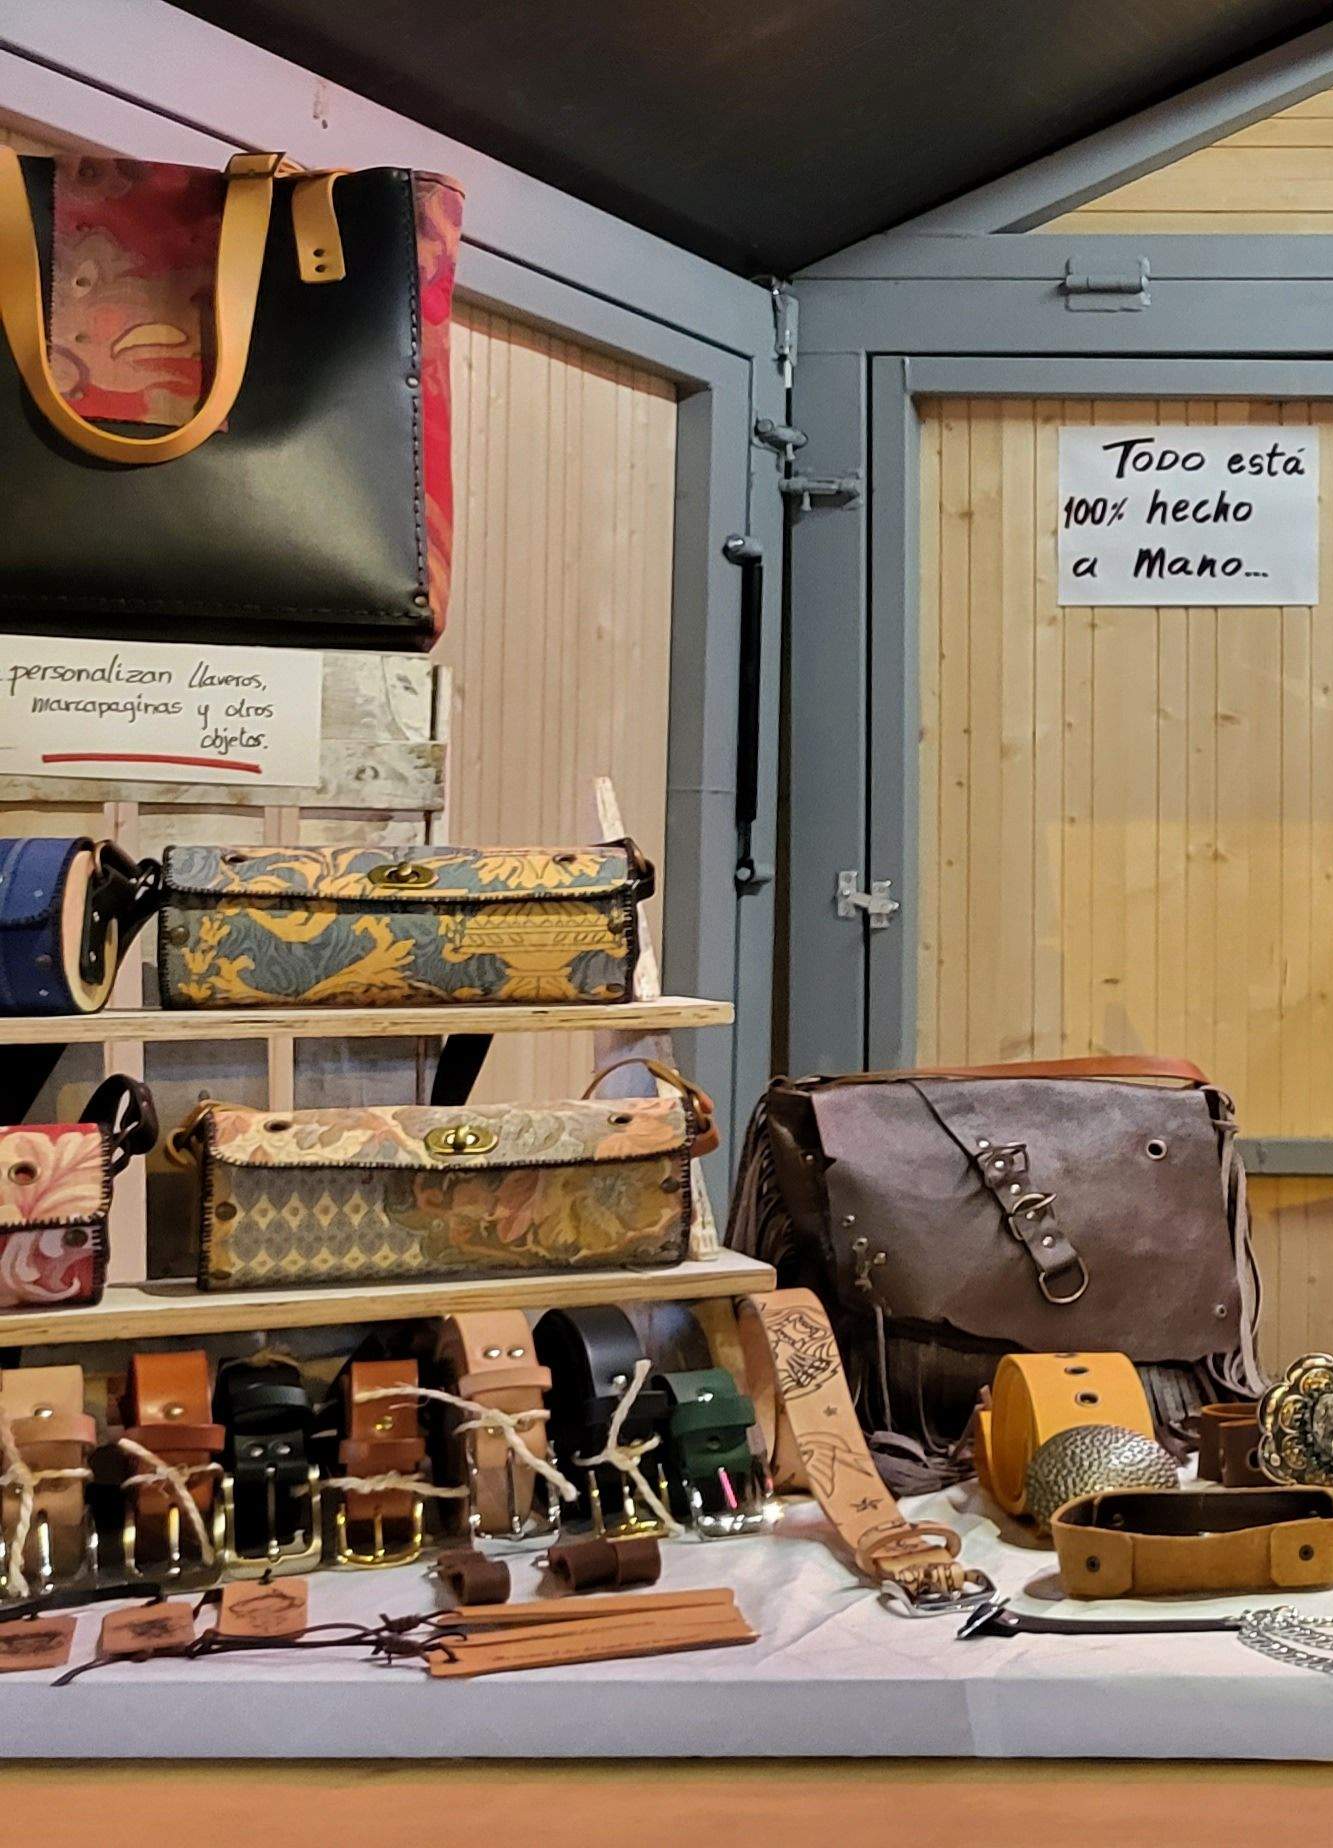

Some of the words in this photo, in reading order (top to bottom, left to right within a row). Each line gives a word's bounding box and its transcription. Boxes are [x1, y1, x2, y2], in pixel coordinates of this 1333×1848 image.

[1227, 442, 1306, 477] está
[1064, 495, 1129, 529] 100%
[1146, 489, 1254, 525] hecho
[1072, 556, 1099, 578] a
[9, 654, 173, 696] personalizan
[197, 703, 210, 730] y
[225, 698, 275, 719] otros
[200, 727, 270, 755] objetos.
